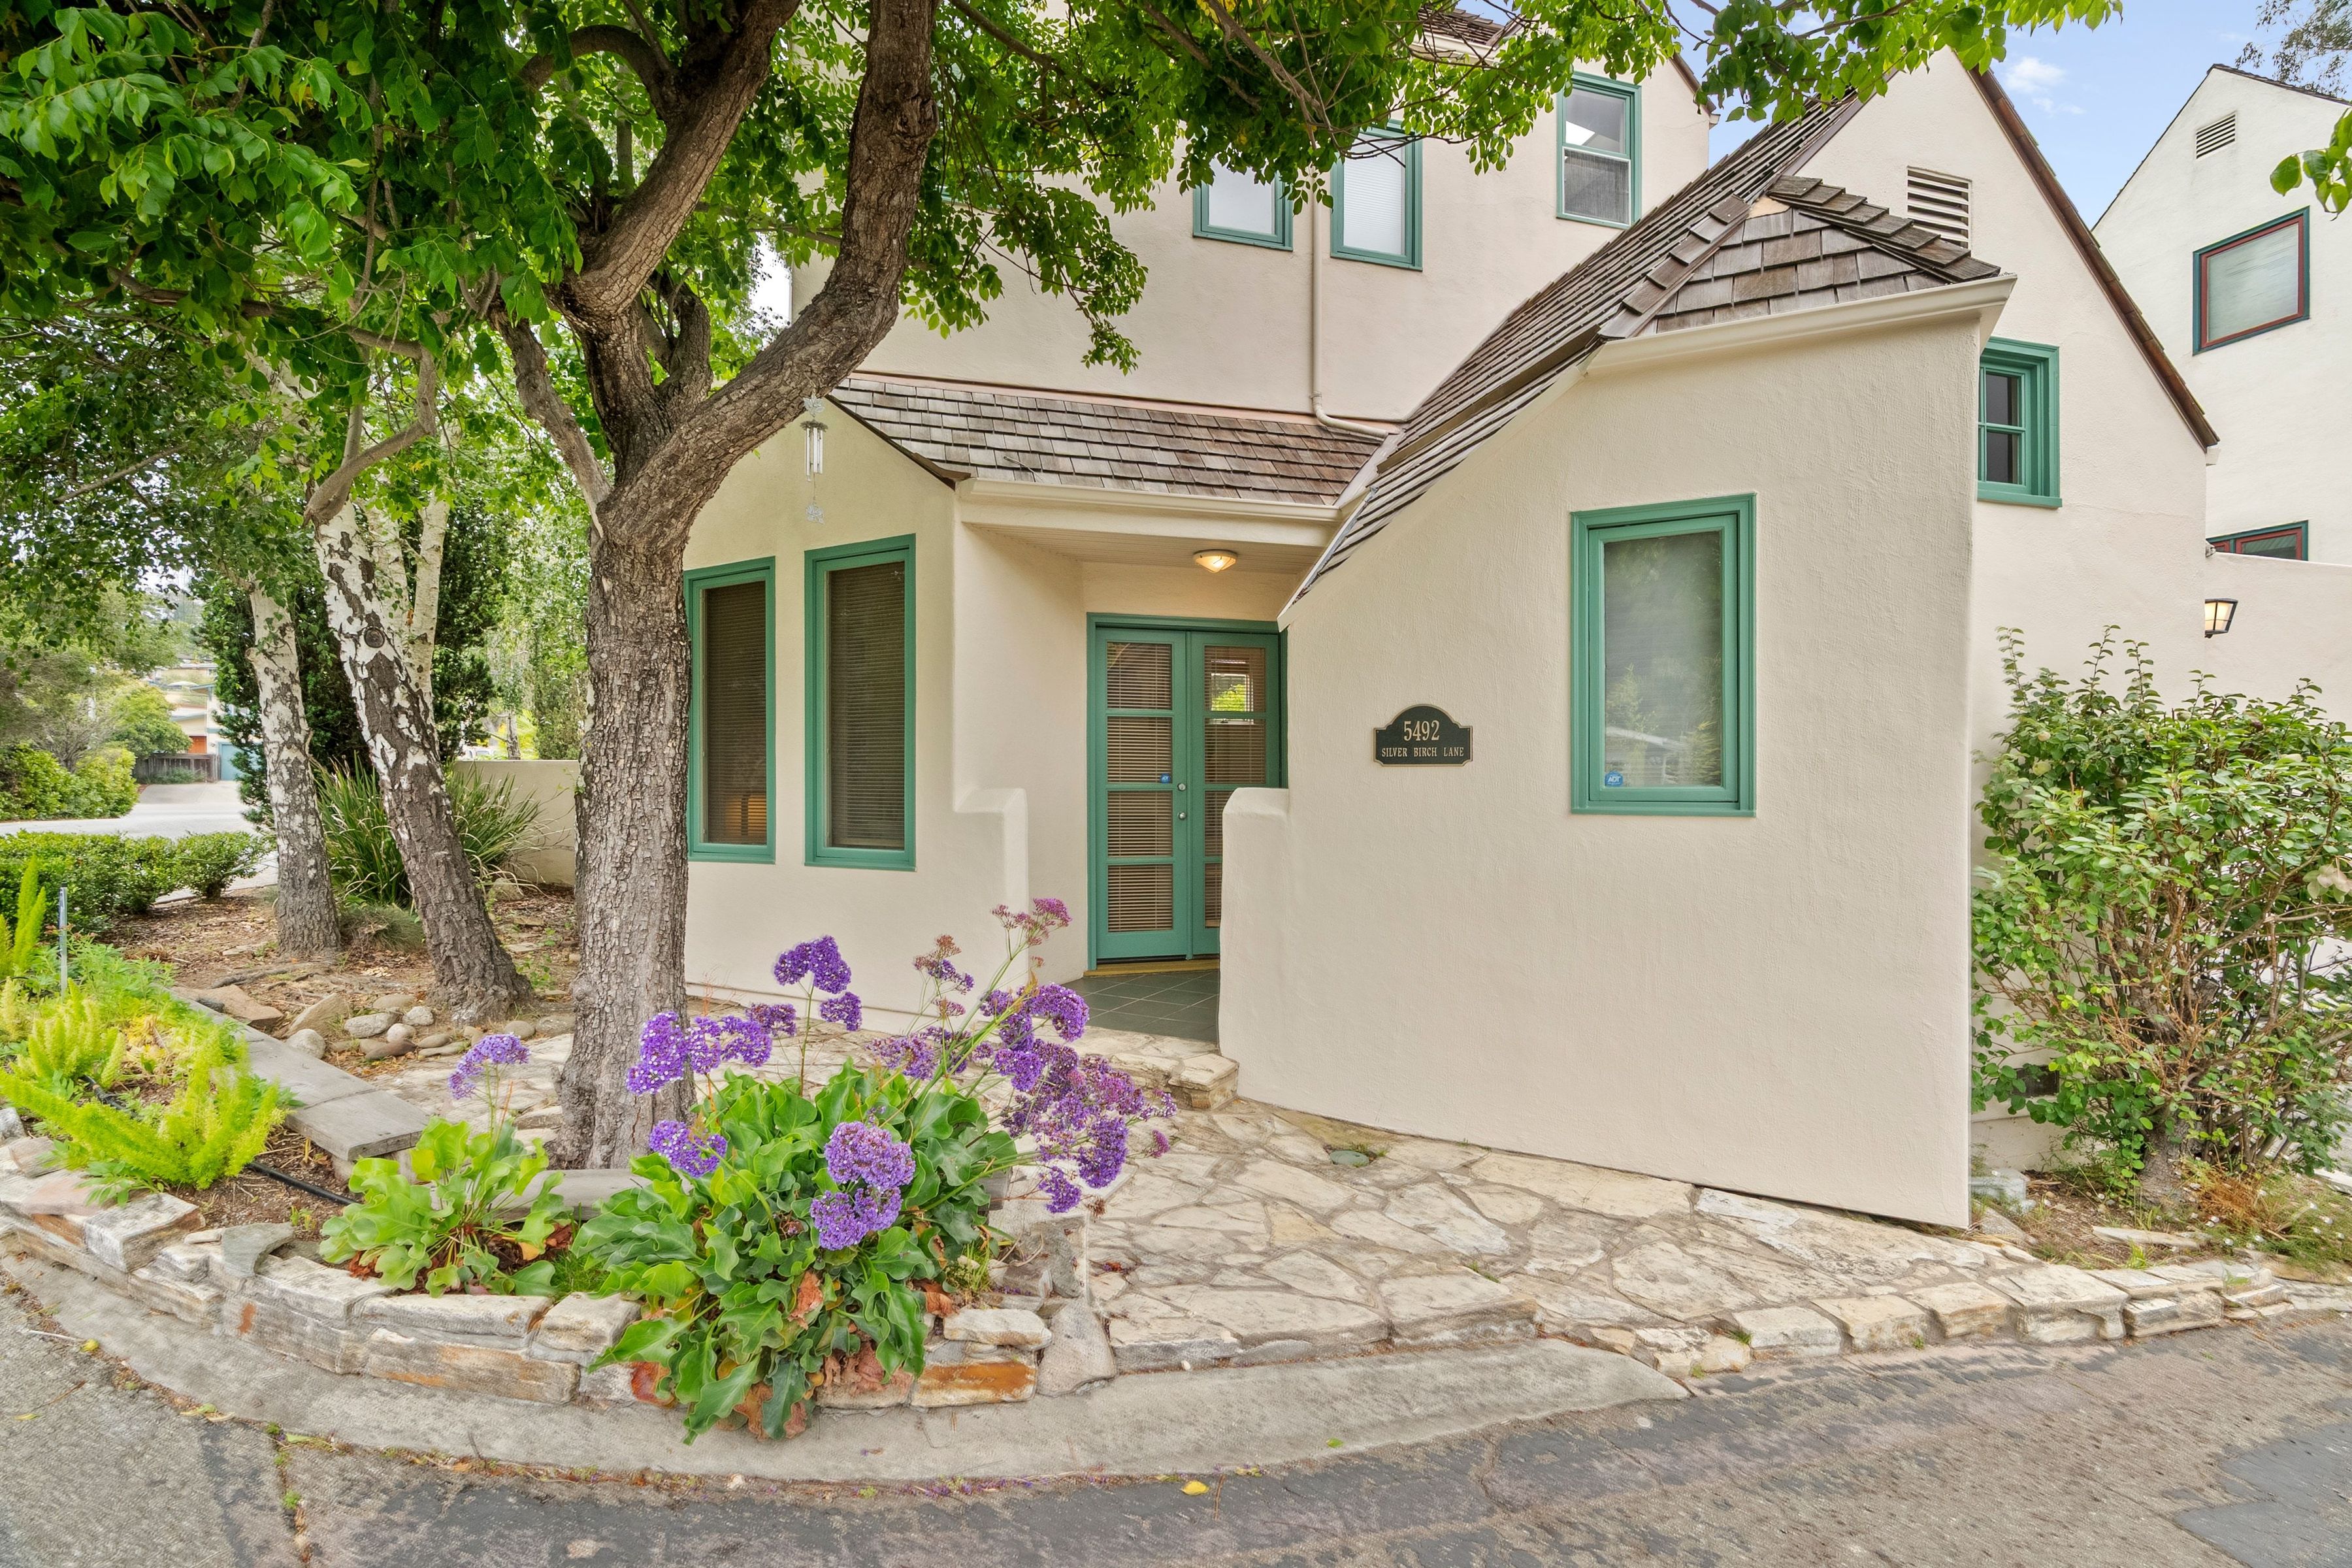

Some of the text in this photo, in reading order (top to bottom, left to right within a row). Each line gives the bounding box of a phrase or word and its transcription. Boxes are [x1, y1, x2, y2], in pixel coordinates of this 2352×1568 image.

[1404, 720, 1440, 742] 5492
[1382, 747, 1465, 757] SILVER BIRCH LANE
